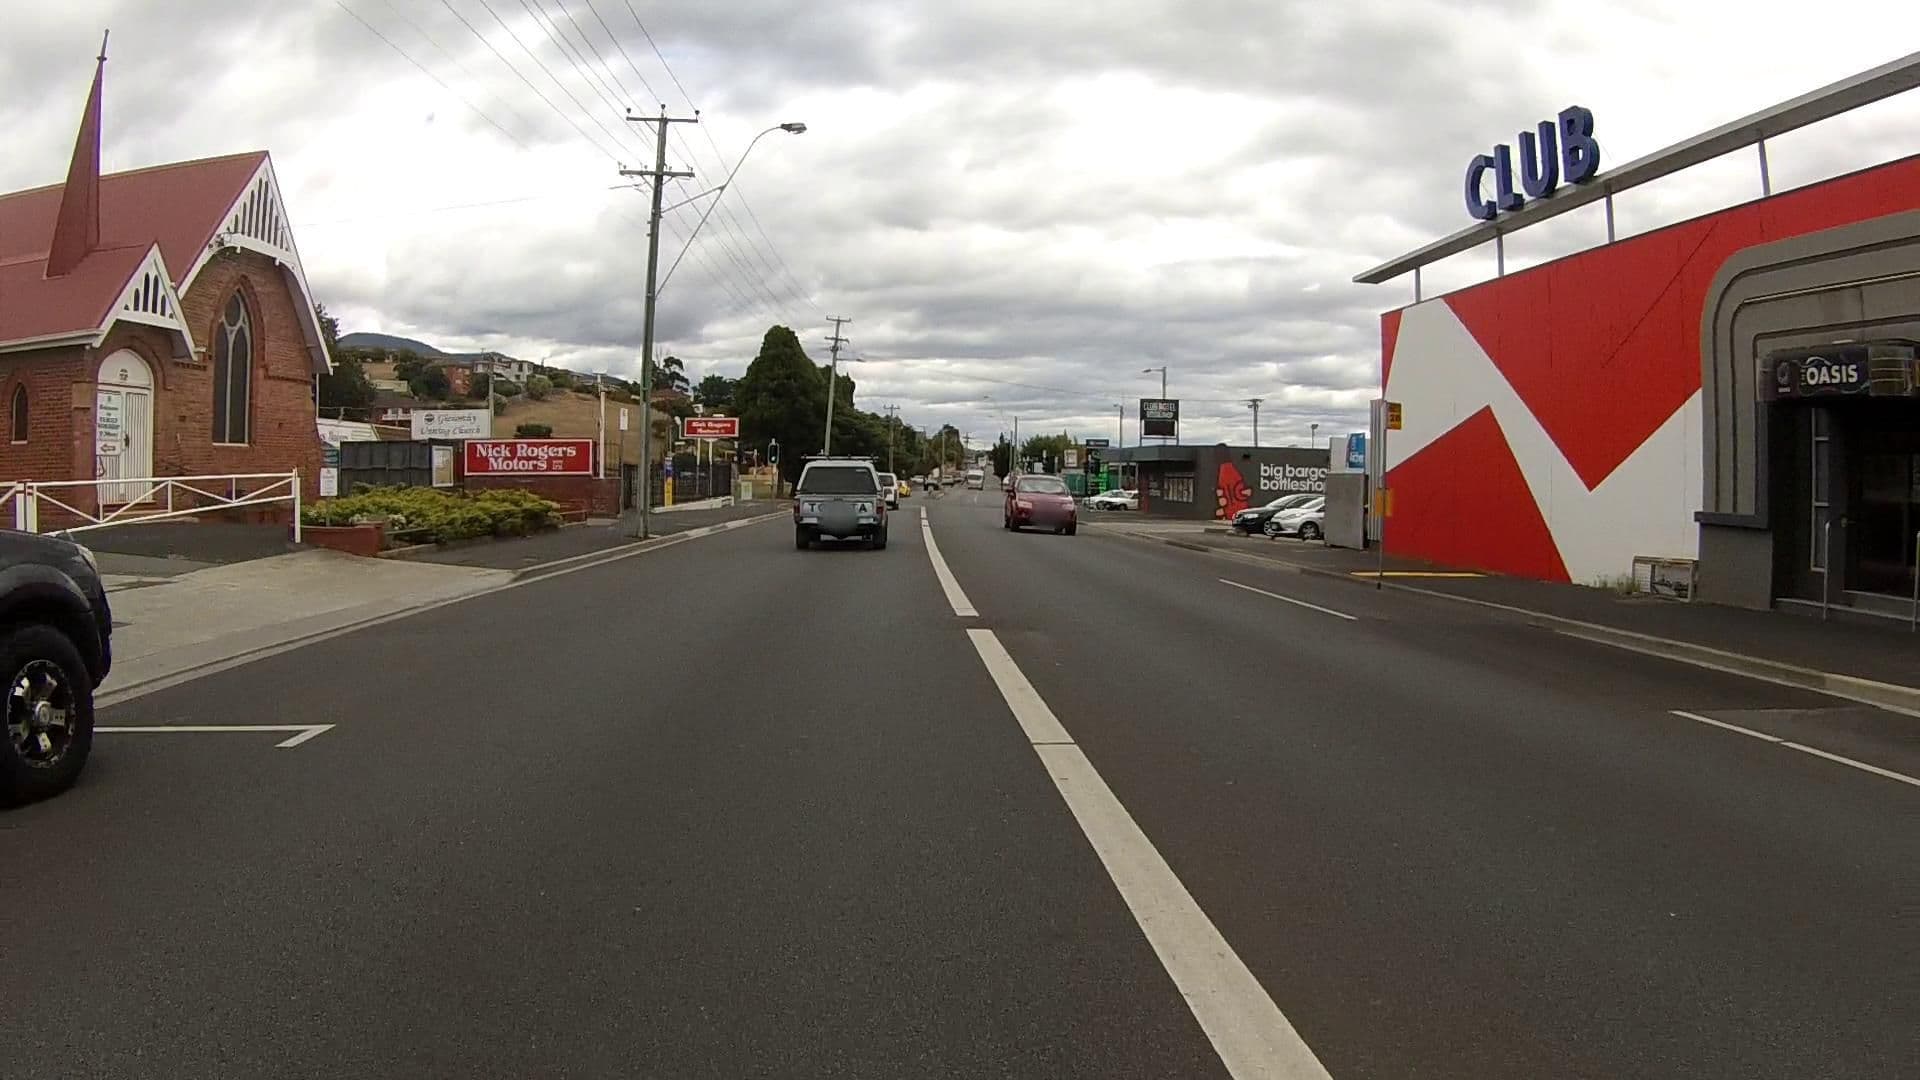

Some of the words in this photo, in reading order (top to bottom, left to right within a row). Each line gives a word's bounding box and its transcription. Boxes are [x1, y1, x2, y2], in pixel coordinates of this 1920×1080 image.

[1465, 105, 1600, 220] CLUB
[1806, 364, 1858, 385] OASIS
[476, 443, 511, 457] Nick
[516, 444, 576, 459] Rogers
[488, 457, 547, 471] Motors
[1260, 463, 1283, 480] big
